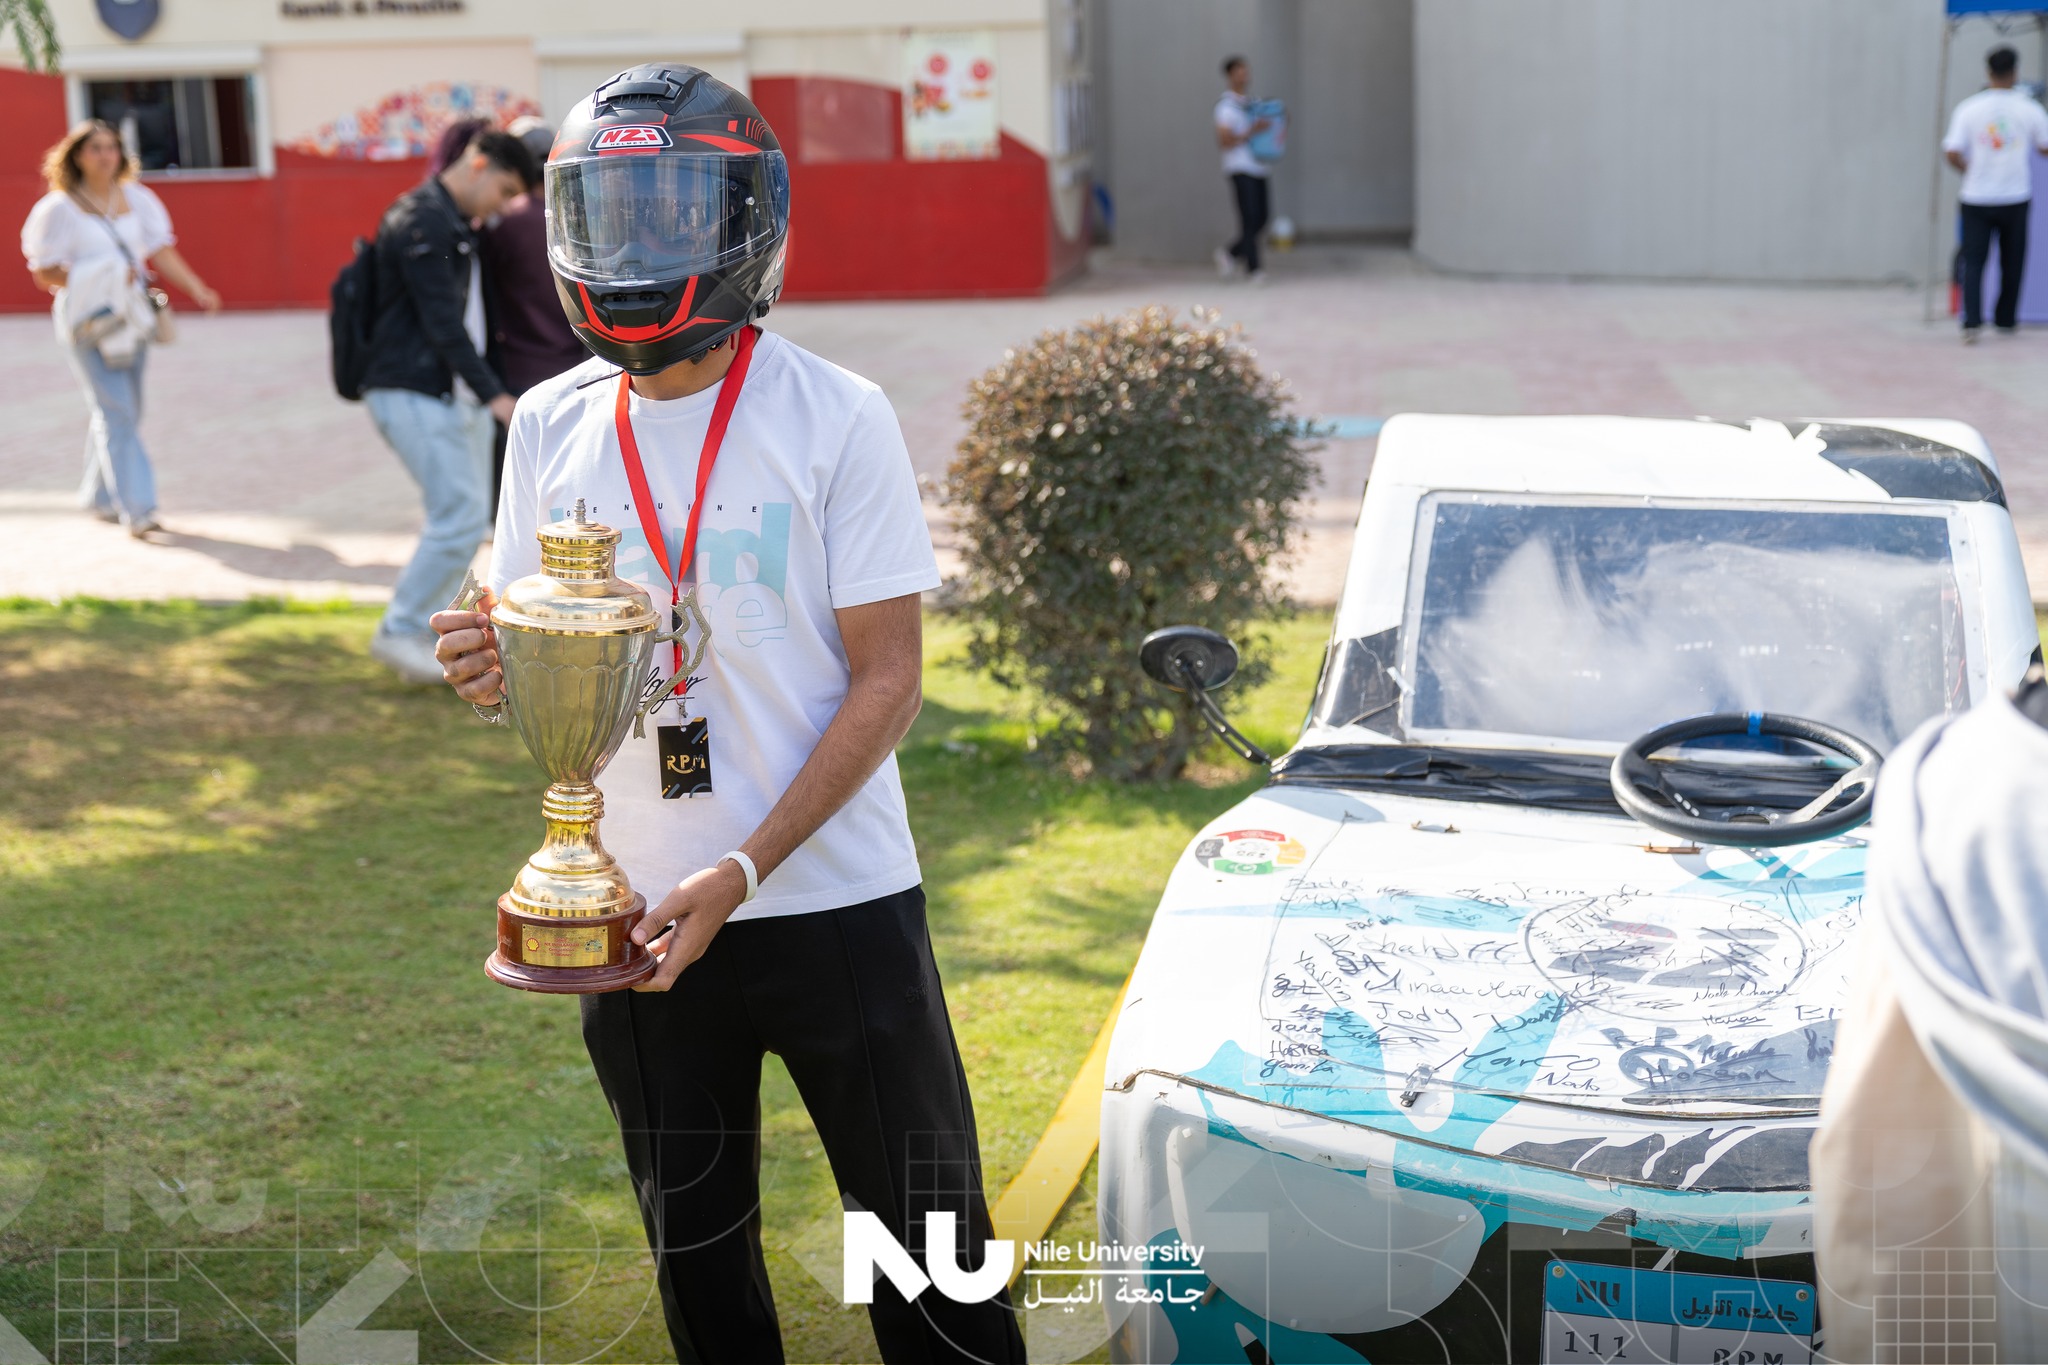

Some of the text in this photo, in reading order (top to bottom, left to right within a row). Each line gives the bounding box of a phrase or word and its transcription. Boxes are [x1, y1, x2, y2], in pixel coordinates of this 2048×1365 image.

[566, 502, 758, 518] GENUINE
[1576, 1279, 1621, 1307] NU
[1564, 1330, 1627, 1358] 111
